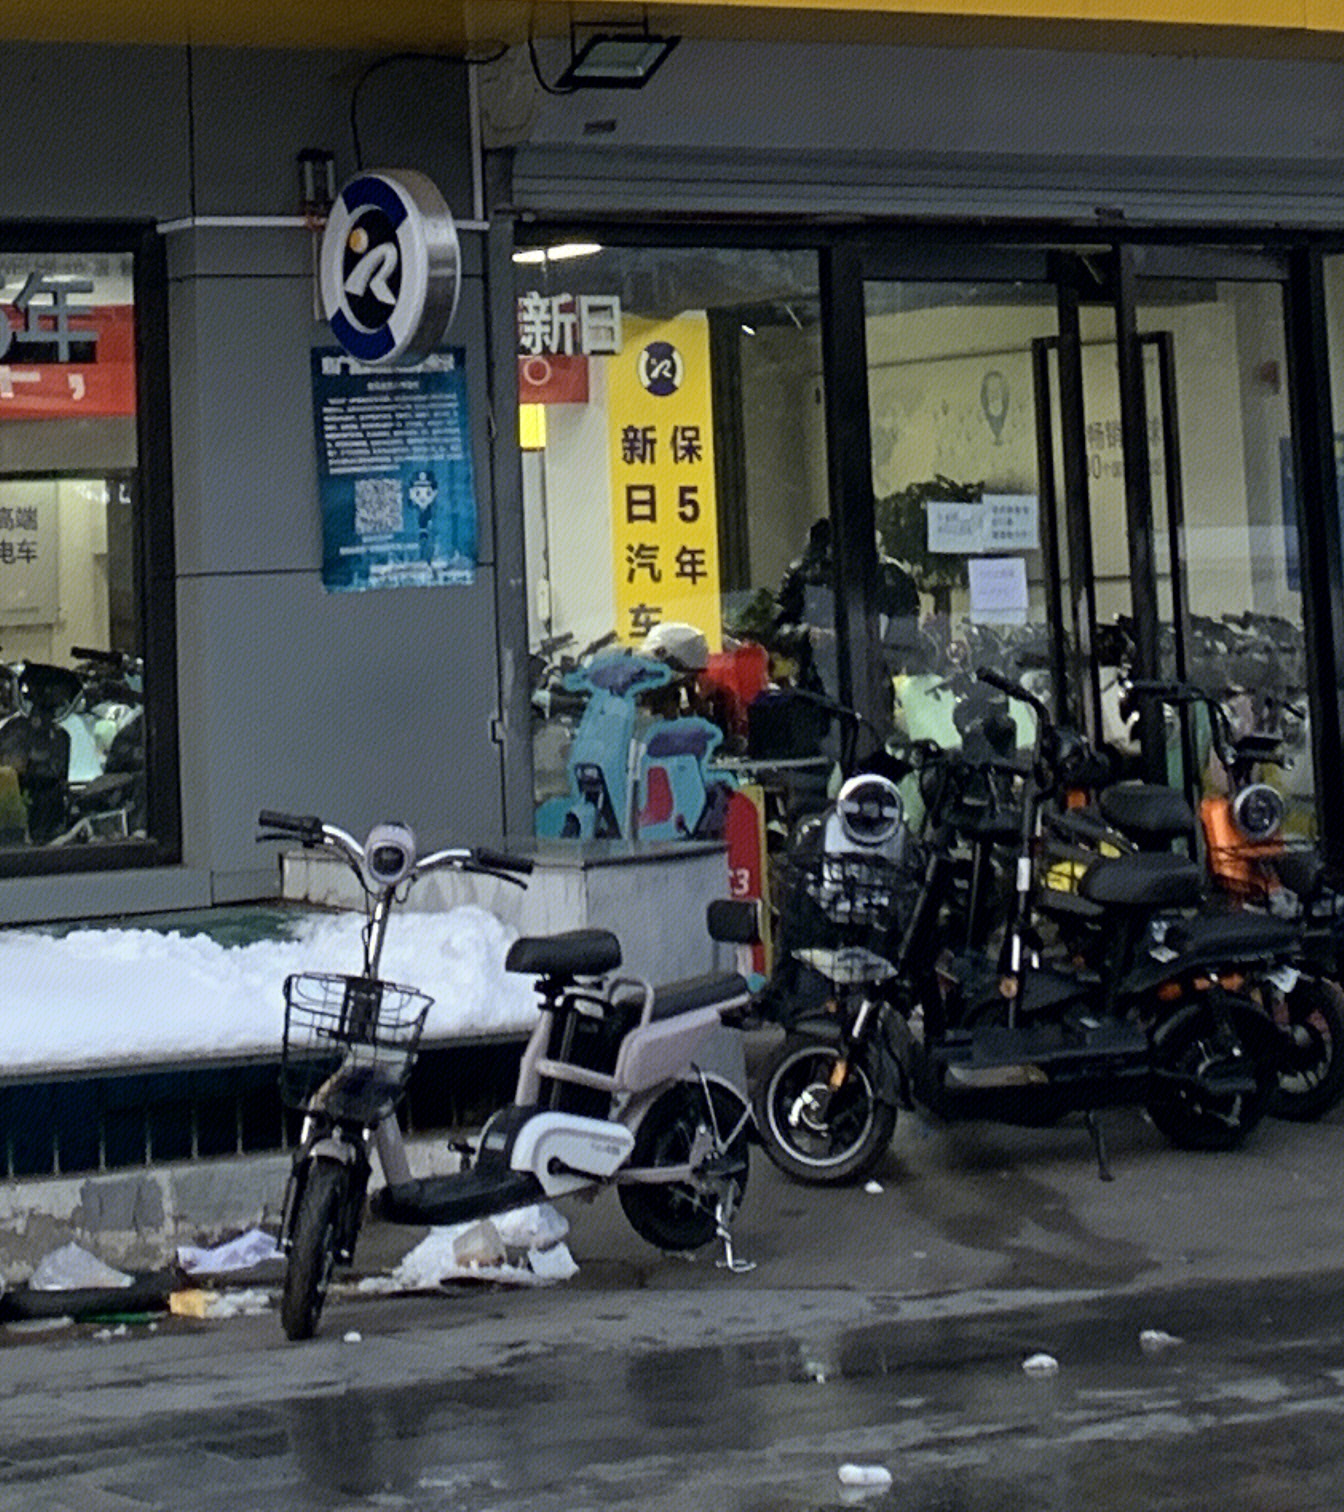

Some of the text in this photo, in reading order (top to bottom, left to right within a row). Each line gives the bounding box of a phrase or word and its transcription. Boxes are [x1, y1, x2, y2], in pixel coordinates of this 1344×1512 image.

[517, 291, 623, 355] 新日
[621, 425, 662, 639] 新日汽车
[670, 425, 708, 586] 保5年
